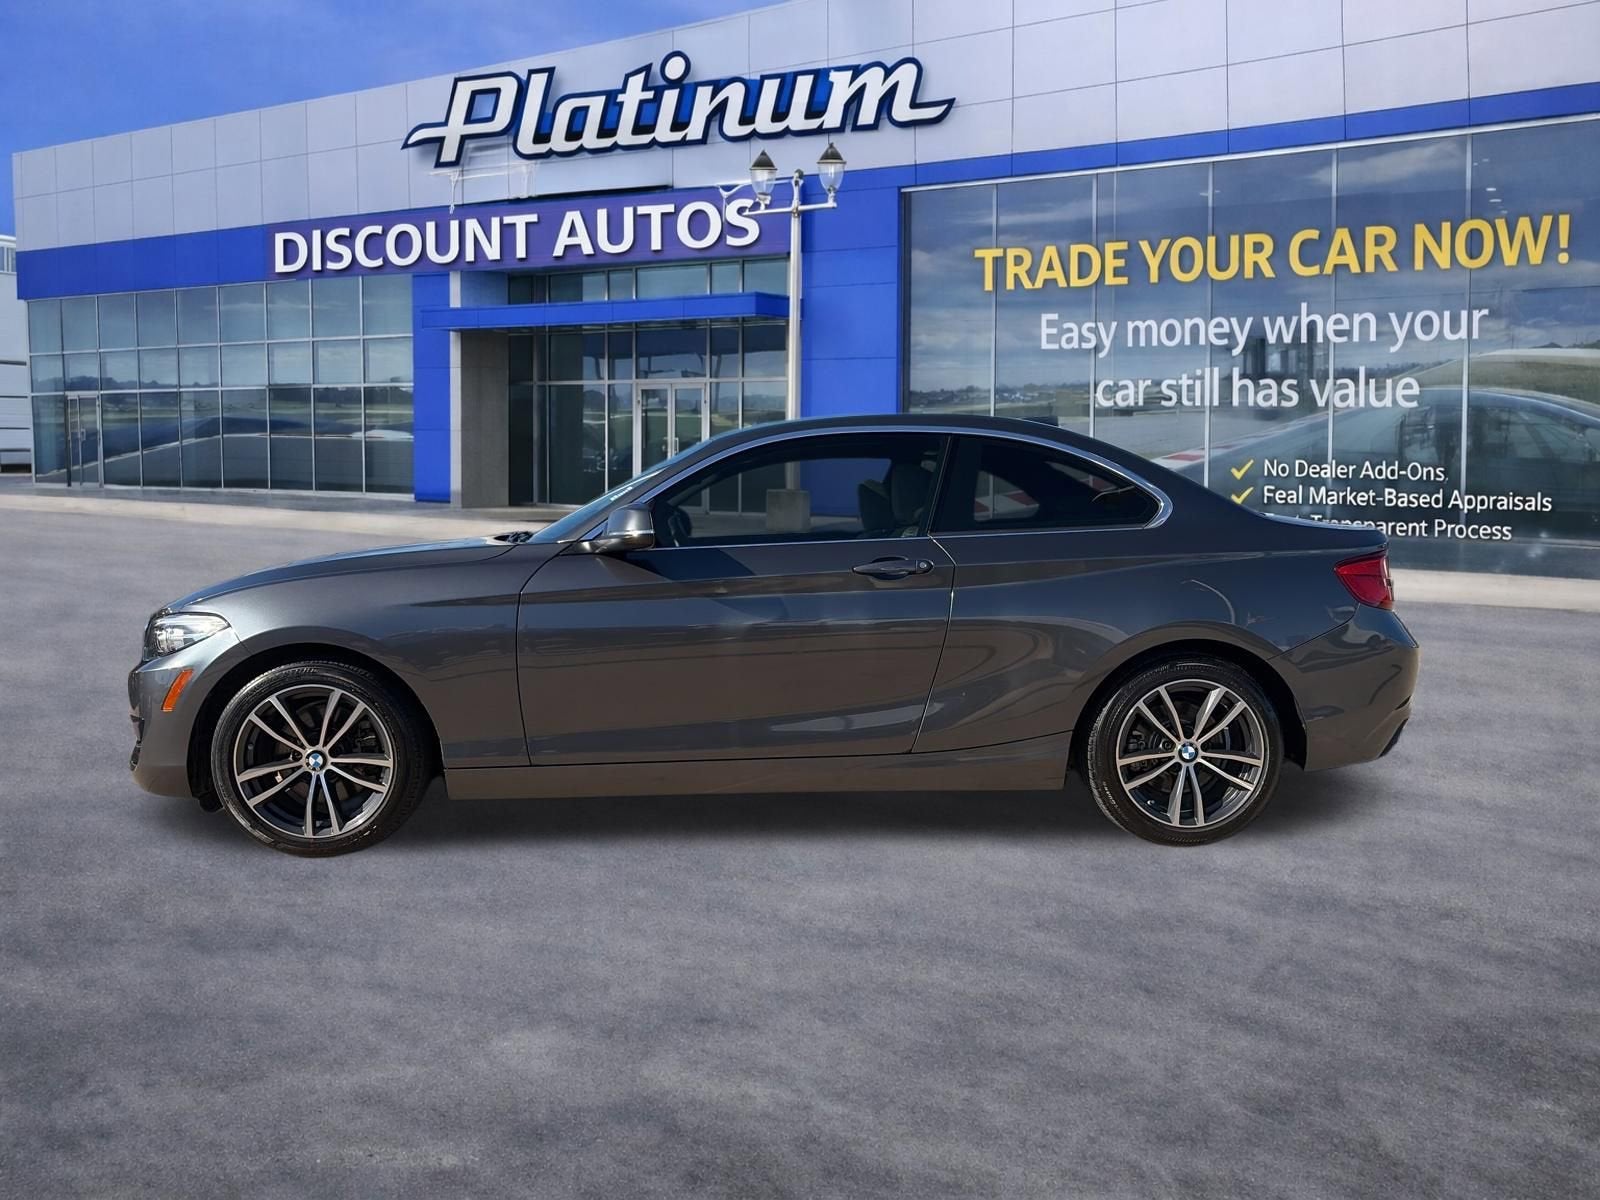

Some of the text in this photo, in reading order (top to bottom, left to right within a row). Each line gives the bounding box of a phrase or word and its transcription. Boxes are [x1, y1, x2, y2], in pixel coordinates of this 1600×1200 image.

[402, 51, 955, 169] Platinum
[274, 199, 761, 274] DISCOUNT AUTOS
[974, 213, 1571, 292] TRADE YOUR CAR NOW!
[1040, 301, 1489, 358] Easy money when your
[1096, 366, 1421, 409] car still has value
[1264, 459, 1289, 478] No
[1295, 460, 1357, 480] Dealer
[1309, 486, 1443, 508] Market-Based
[1448, 490, 1552, 513] Appraisals
[1434, 518, 1512, 541] Process
